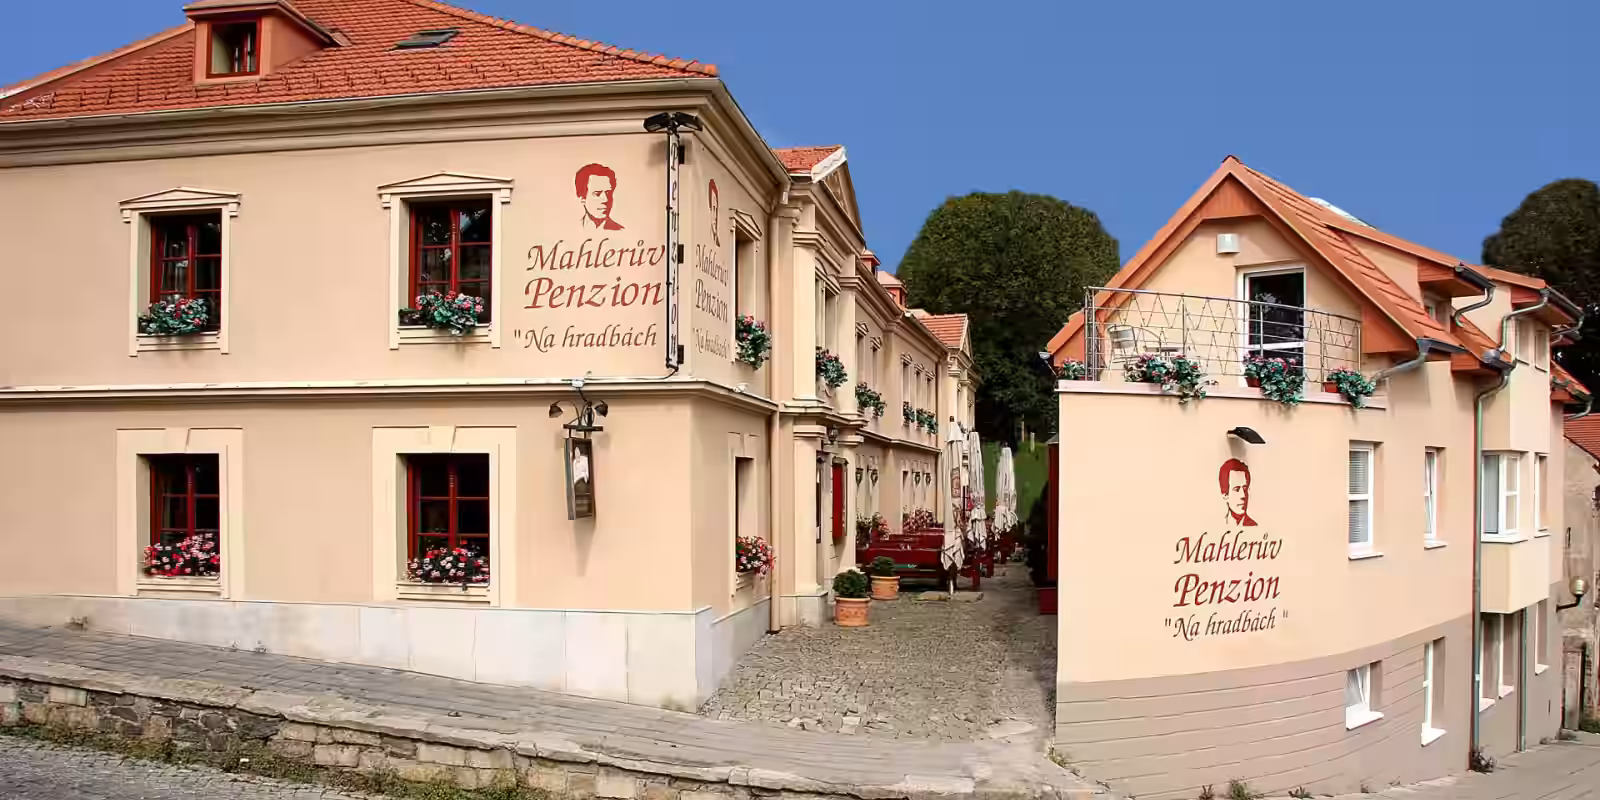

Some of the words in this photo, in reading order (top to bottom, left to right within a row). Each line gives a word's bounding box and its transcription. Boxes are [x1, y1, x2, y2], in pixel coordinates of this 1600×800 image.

[526, 238, 666, 271] Mahlerův
[669, 142, 678, 356] Penzion
[524, 277, 664, 309] Penzion
[695, 278, 729, 324] Penzion
[562, 323, 657, 347] hradbách
[1174, 530, 1282, 564] Mahlerův
[1173, 571, 1280, 607] Penzion
